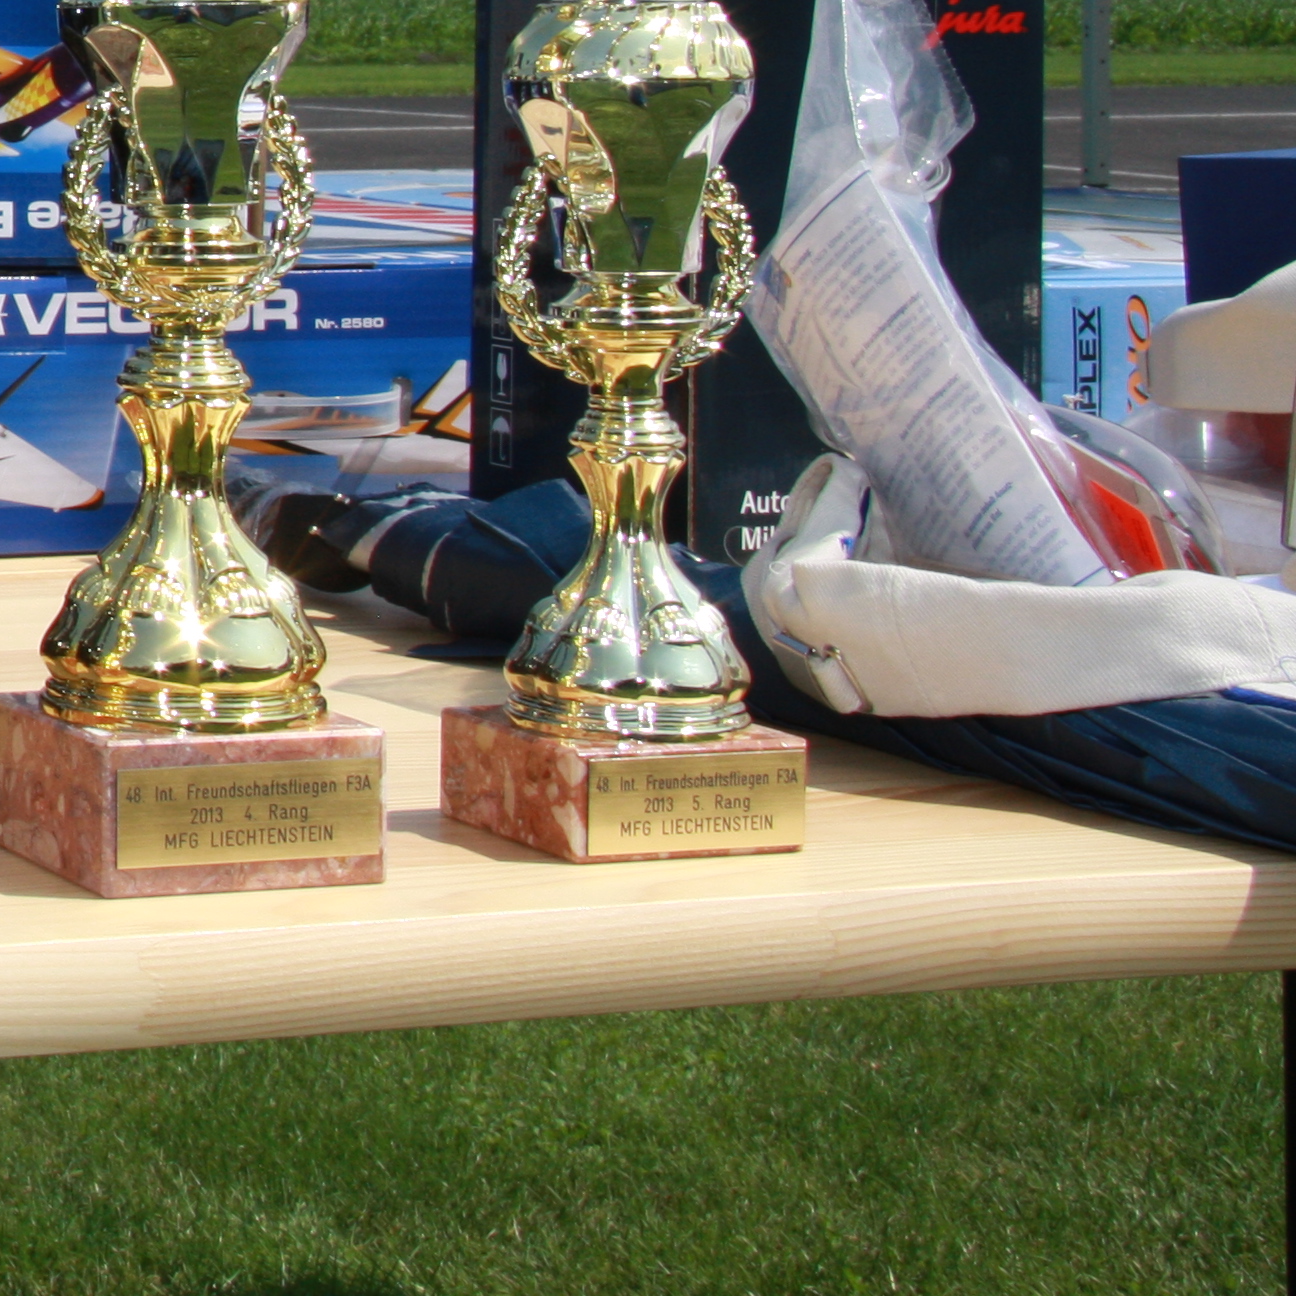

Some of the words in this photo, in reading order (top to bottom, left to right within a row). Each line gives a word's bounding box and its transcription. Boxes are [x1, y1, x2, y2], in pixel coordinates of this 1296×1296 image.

[314, 318, 339, 329] Nr.
[341, 317, 385, 329] 2580
[125, 787, 145, 803] 48.
[155, 785, 177, 802] Int.
[187, 778, 337, 801] Freundschaftsfliegen
[346, 774, 372, 792] F3A
[596, 777, 613, 793] 48.
[620, 776, 639, 792] Int.
[646, 770, 770, 791] Freundschaftsfliegen
[776, 768, 799, 785] F3A
[190, 807, 224, 824] 2013
[244, 805, 258, 822] 4.
[268, 803, 309, 822] Rang
[644, 796, 674, 814] 2013
[692, 795, 705, 811] 5.
[715, 794, 751, 811] Rang
[164, 832, 199, 850] MFG
[210, 824, 334, 848] LIECHTENSTEIN
[620, 821, 652, 838] MFG
[661, 814, 774, 836] LIECHTENSTEIN
